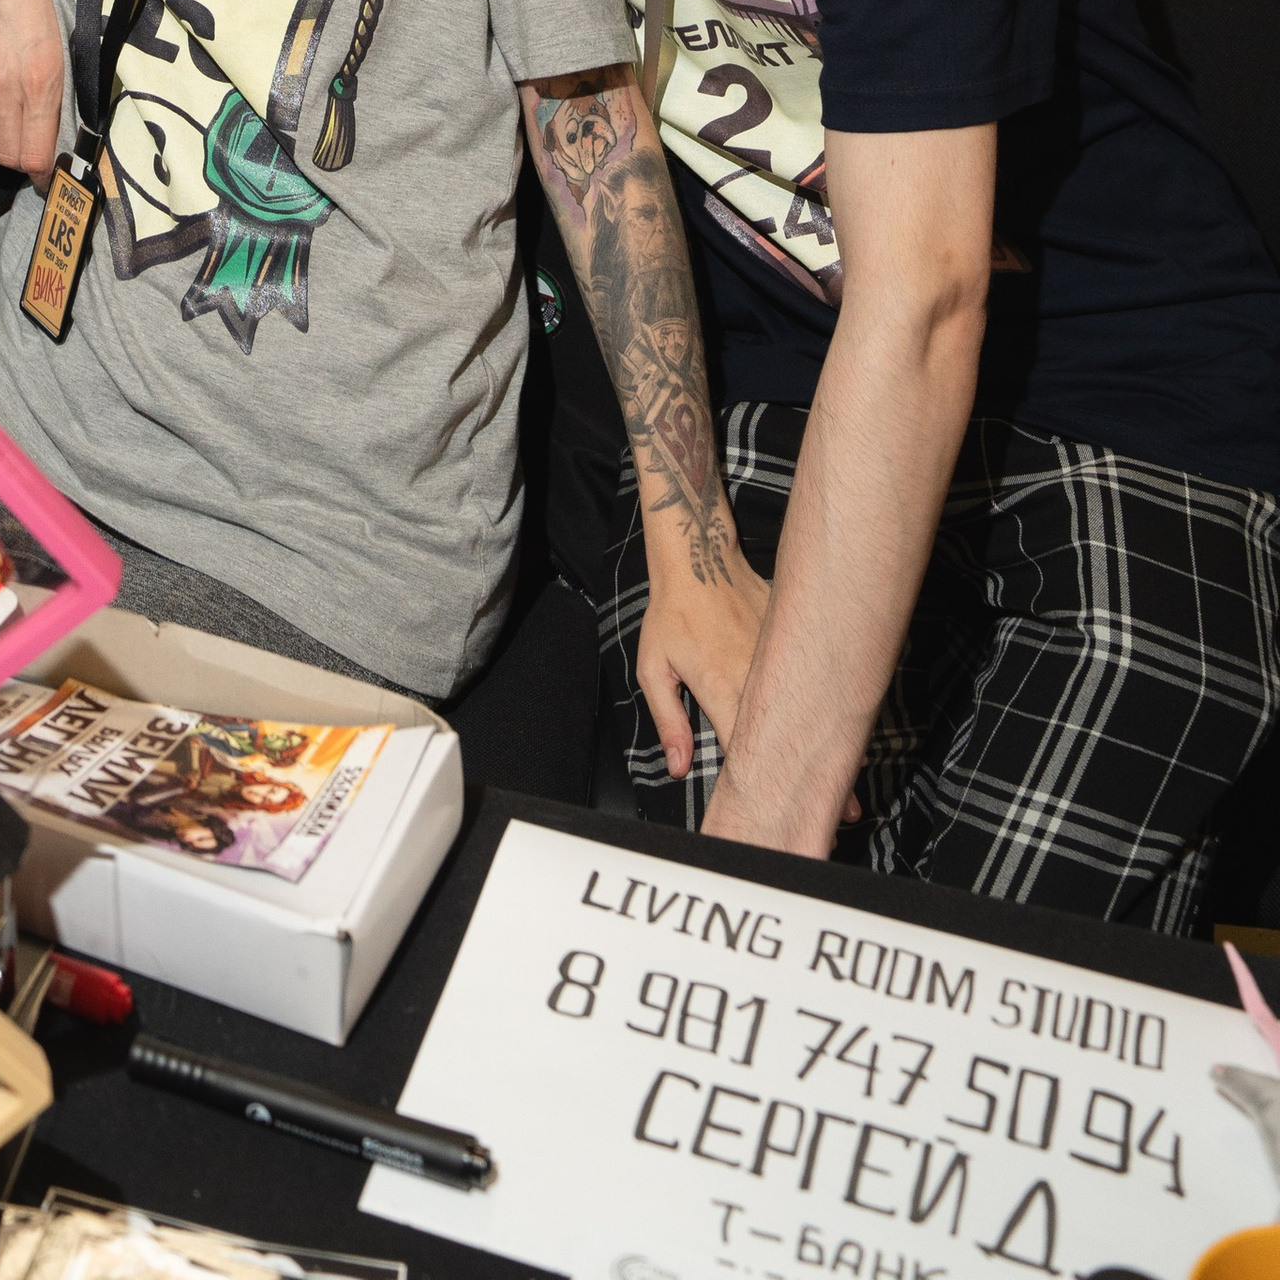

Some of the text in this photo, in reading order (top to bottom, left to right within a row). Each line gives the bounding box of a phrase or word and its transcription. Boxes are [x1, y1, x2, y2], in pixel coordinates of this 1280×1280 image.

[32, 264, 66, 311] ВИКА
[47, 213, 76, 258] LRS
[69, 716, 190, 810] ЗЕМЛИ
[580, 869, 1167, 1072] LIVING ROOM STUDIO
[546, 949, 1186, 1198] 8 981 747 50 94
[632, 1068, 1062, 1276] СЕРГЕЙ Д
